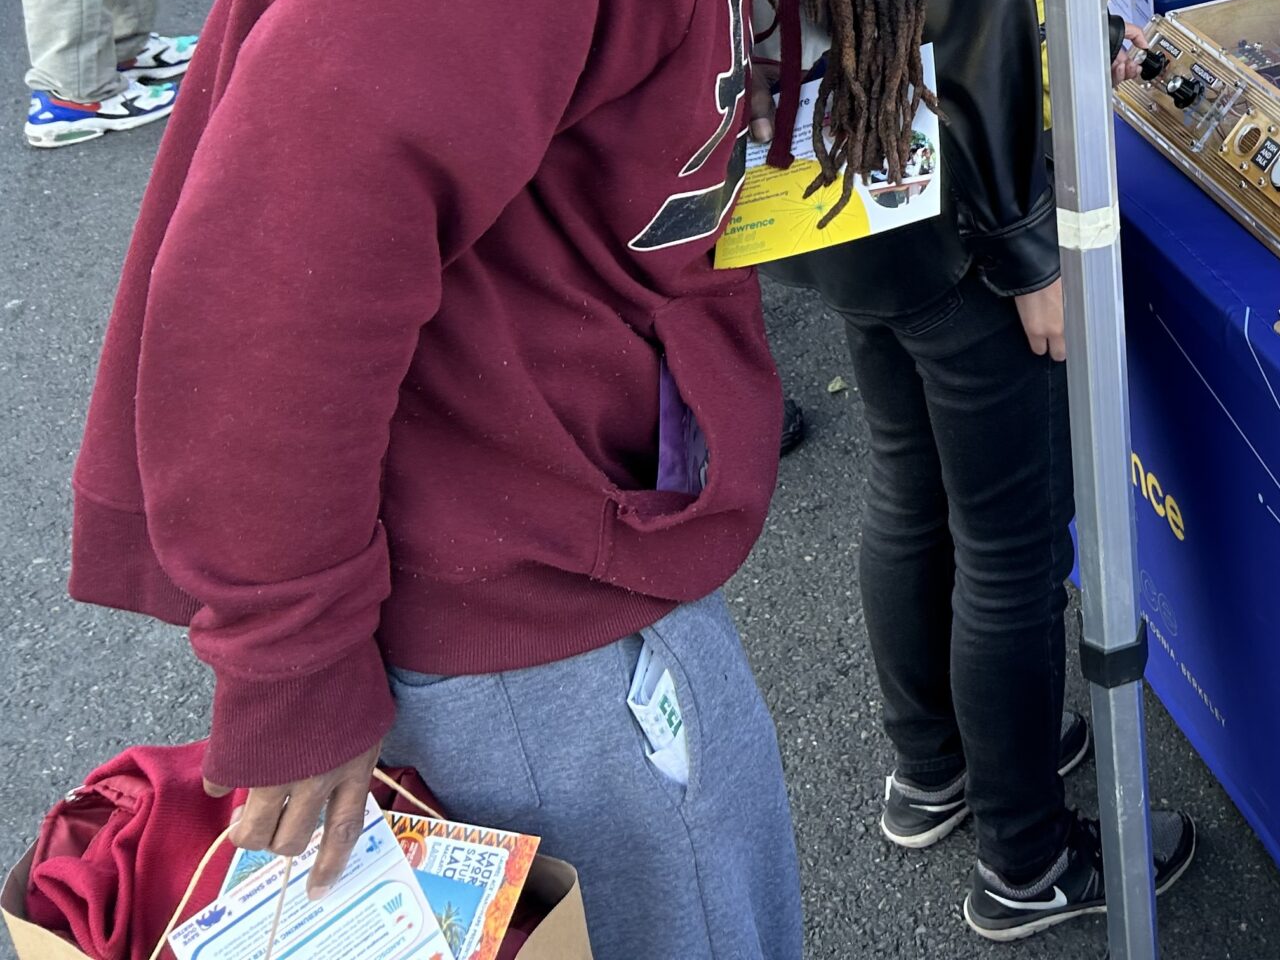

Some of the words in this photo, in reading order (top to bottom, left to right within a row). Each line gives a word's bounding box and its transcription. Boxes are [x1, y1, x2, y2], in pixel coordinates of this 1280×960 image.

[1264, 139, 1278, 152] PUSH
[1255, 155, 1268, 167] TALK
[1260, 149, 1272, 160] AND
[724, 218, 775, 236] Lawrence
[1180, 661, 1226, 728] BERKELEY
